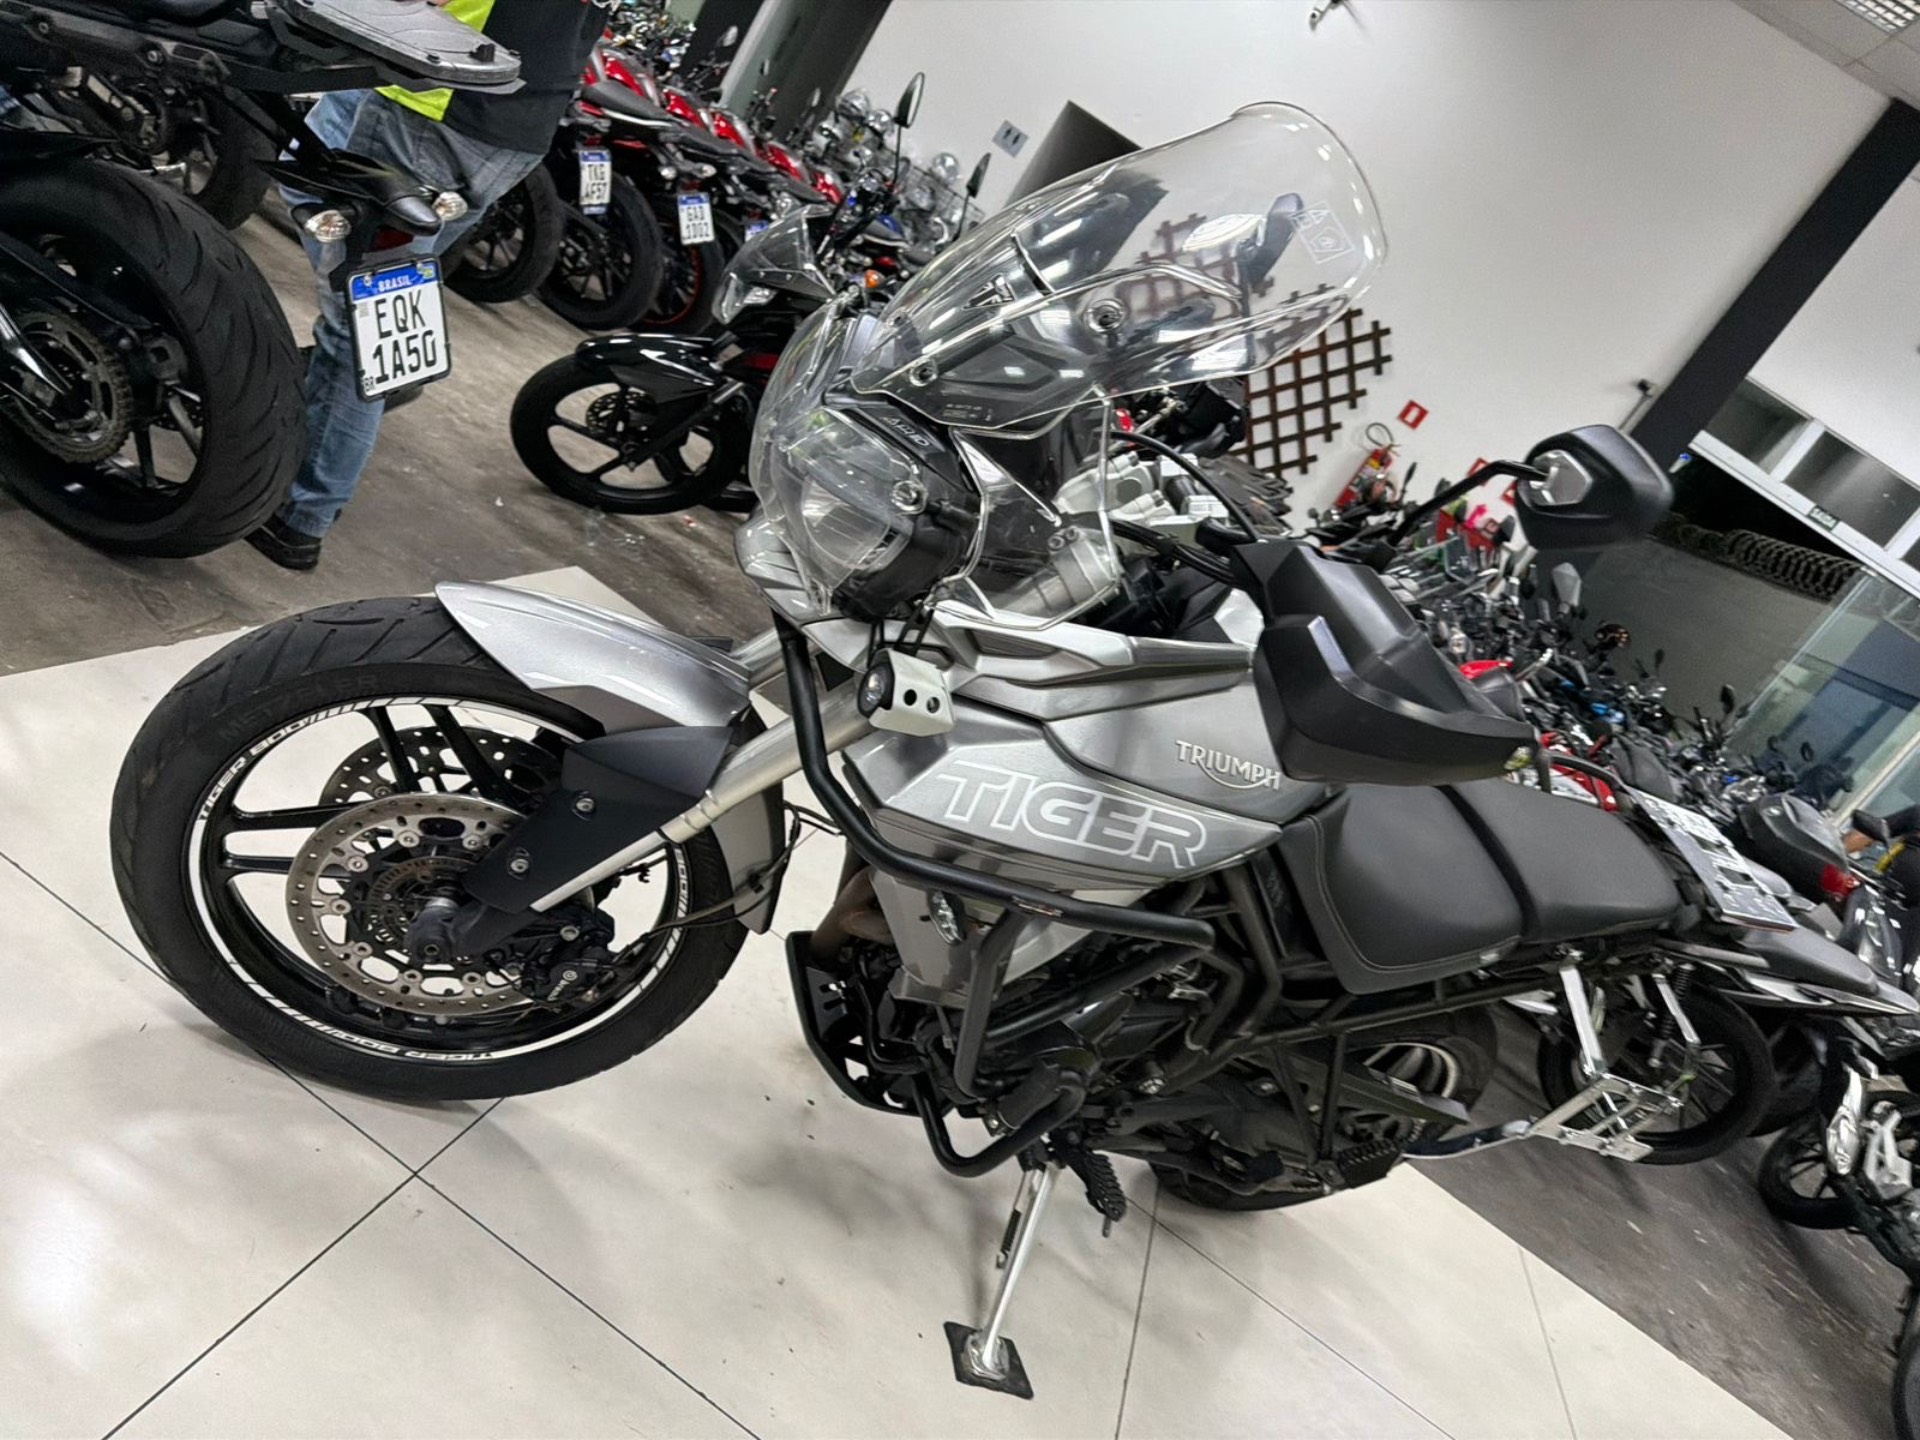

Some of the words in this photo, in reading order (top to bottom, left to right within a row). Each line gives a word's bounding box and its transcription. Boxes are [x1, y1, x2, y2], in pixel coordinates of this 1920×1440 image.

[378, 275, 413, 292] BRASIL
[374, 289, 426, 339] EQK
[372, 329, 437, 384] 1A50
[199, 756, 247, 820] TIGER
[1176, 740, 1282, 791] TRIUMPH
[938, 760, 1207, 869] TIGER
